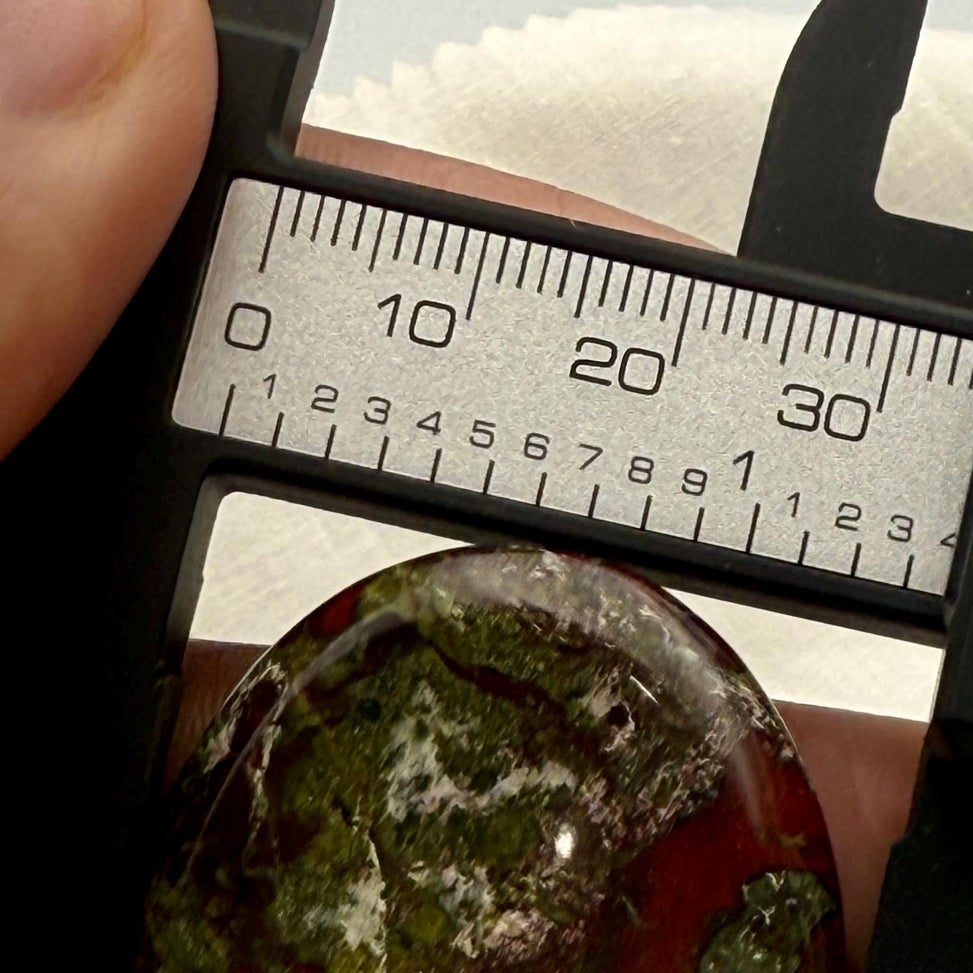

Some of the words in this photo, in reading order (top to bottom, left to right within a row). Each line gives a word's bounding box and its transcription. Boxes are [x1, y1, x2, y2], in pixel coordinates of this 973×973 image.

[224, 303, 271, 350] 0
[378, 294, 456, 348] 10
[569, 337, 665, 395] 20
[777, 384, 871, 442] 30
[263, 373, 277, 399] 1
[311, 384, 338, 413] 2
[364, 397, 390, 425] 3
[416, 411, 442, 436] 4
[469, 420, 496, 448] 5
[523, 433, 550, 460] 6
[578, 443, 603, 470] 7
[628, 456, 654, 484] 8
[681, 468, 708, 496] 9
[733, 450, 755, 491] 1
[787, 492, 800, 517] 1
[834, 503, 861, 531] 2
[887, 515, 913, 542] 3
